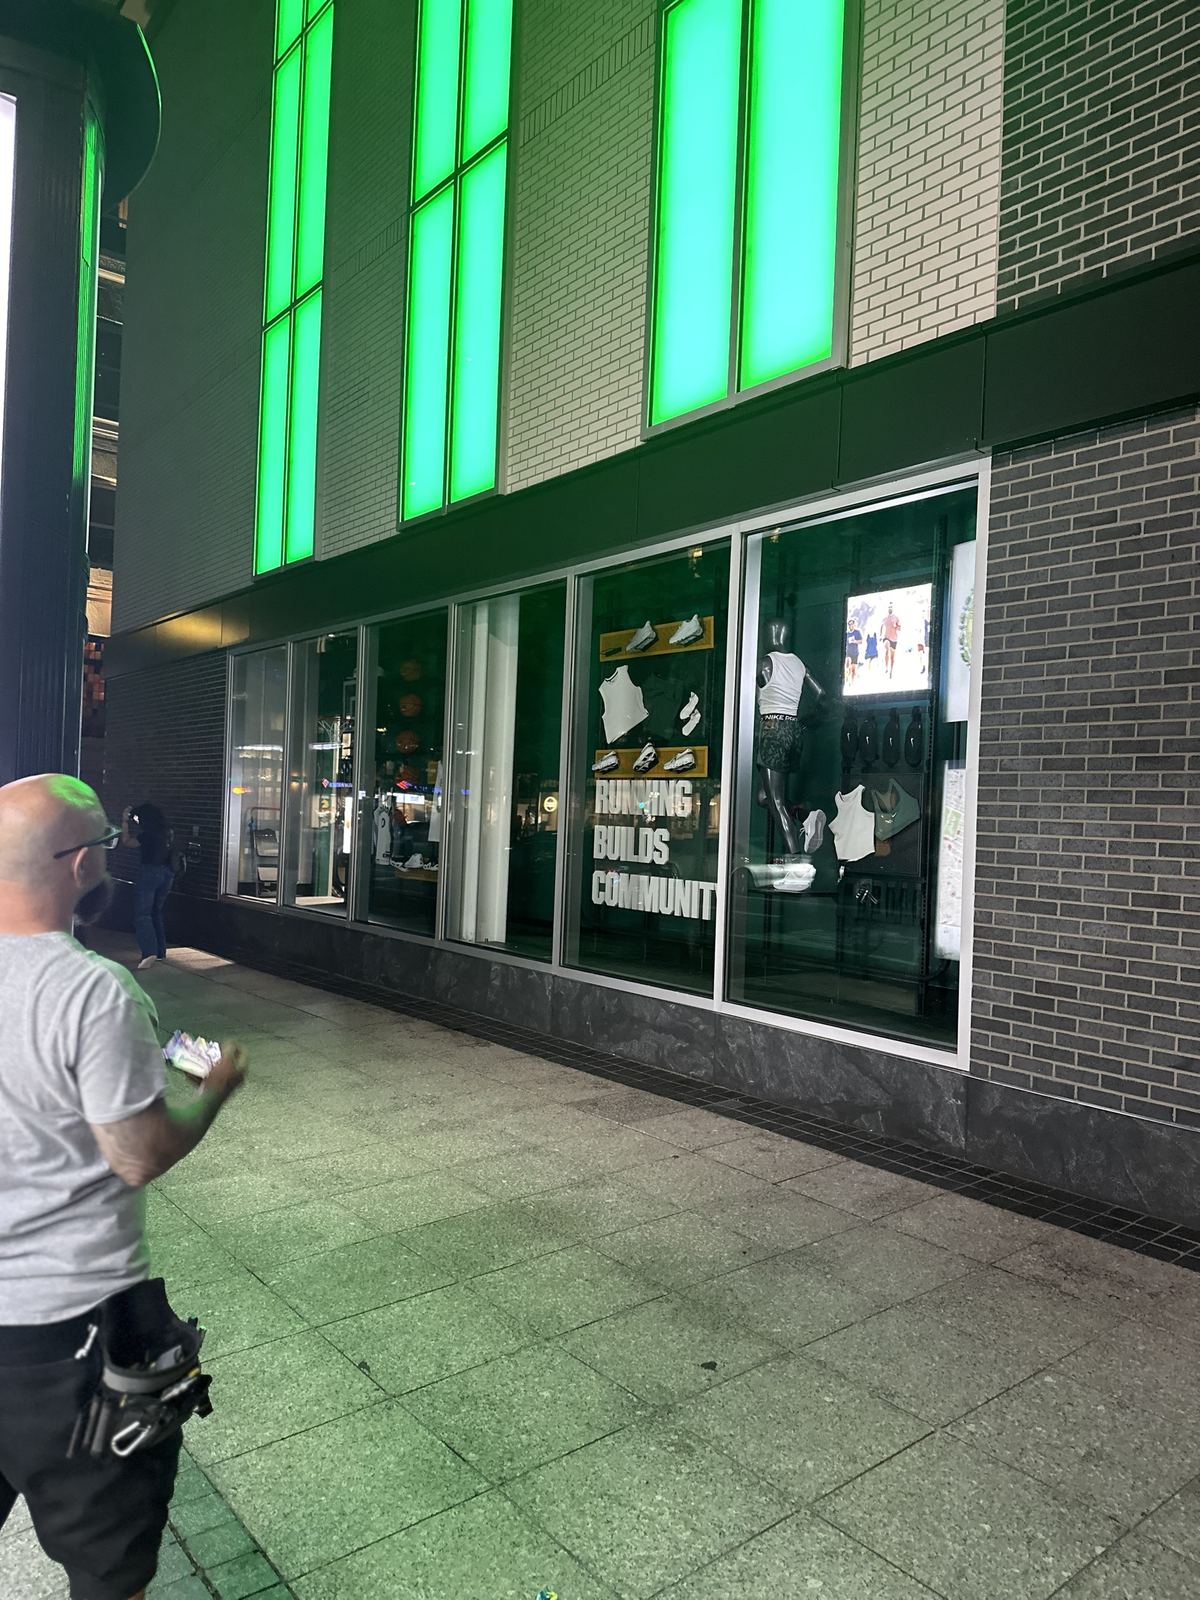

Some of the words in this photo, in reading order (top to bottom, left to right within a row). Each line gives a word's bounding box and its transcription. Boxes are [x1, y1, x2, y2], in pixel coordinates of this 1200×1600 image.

[595, 779, 693, 817] RUNNING
[593, 824, 670, 865] BUILDS
[592, 869, 718, 920] COMMUNIT
